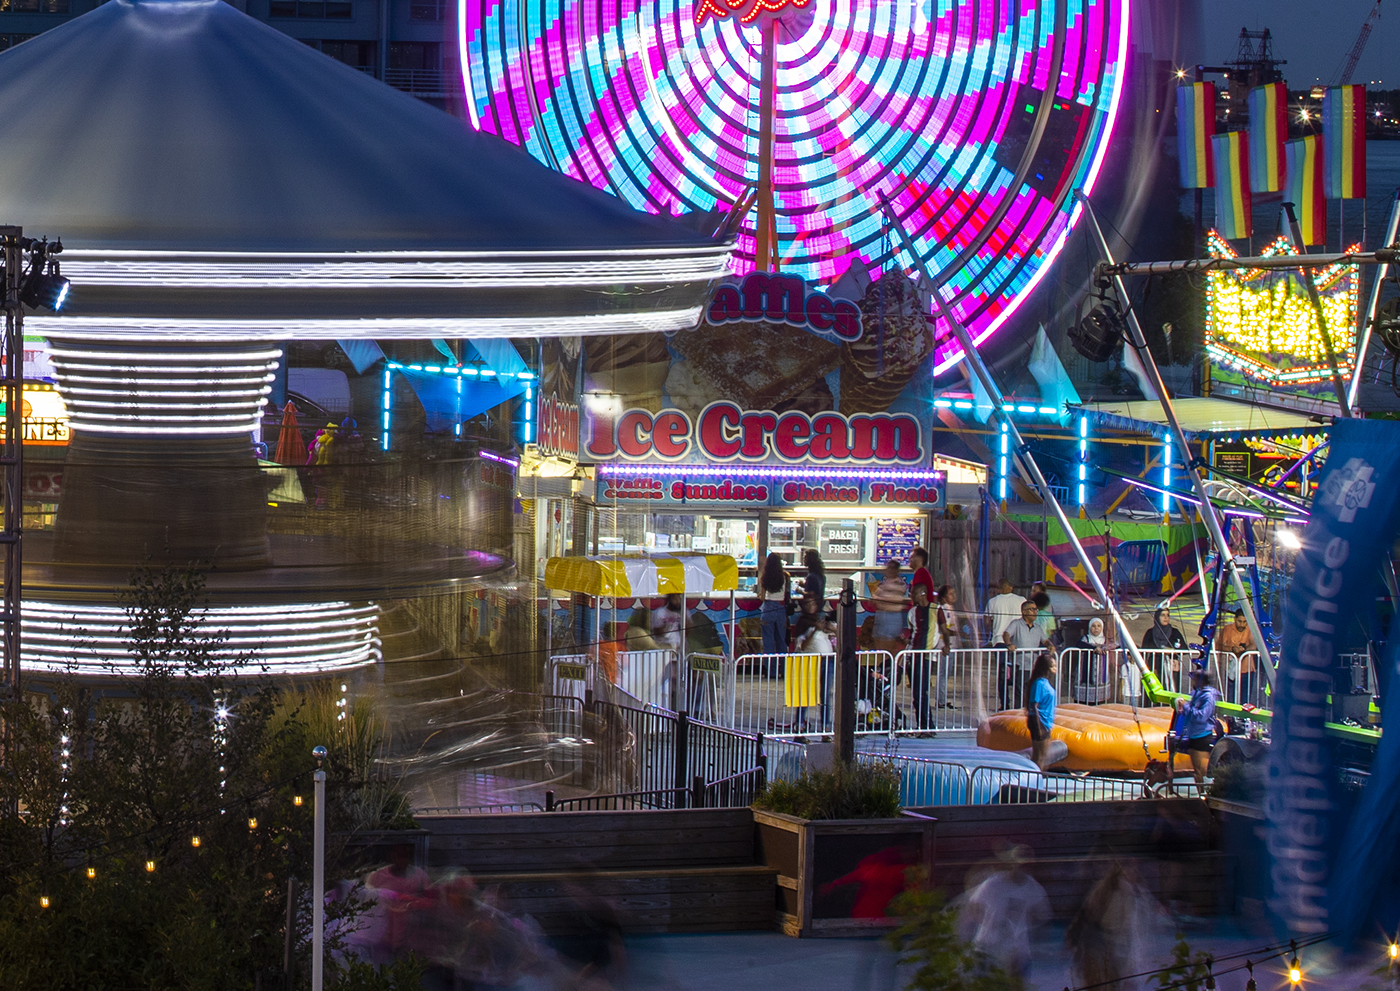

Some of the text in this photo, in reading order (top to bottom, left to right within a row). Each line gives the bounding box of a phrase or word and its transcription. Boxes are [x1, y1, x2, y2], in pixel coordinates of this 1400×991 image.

[708, 271, 862, 341] affles
[587, 404, 921, 461] Ice Cream
[606, 478, 662, 490] Waffle
[604, 489, 664, 499] Cones
[671, 480, 768, 501] Sundaes
[783, 481, 938, 503] Shakes Floats
[829, 530, 859, 540] BAKED
[829, 544, 858, 554] FRESH
[695, 658, 719, 669] ENTRANCE
[560, 666, 584, 679] EXIT
